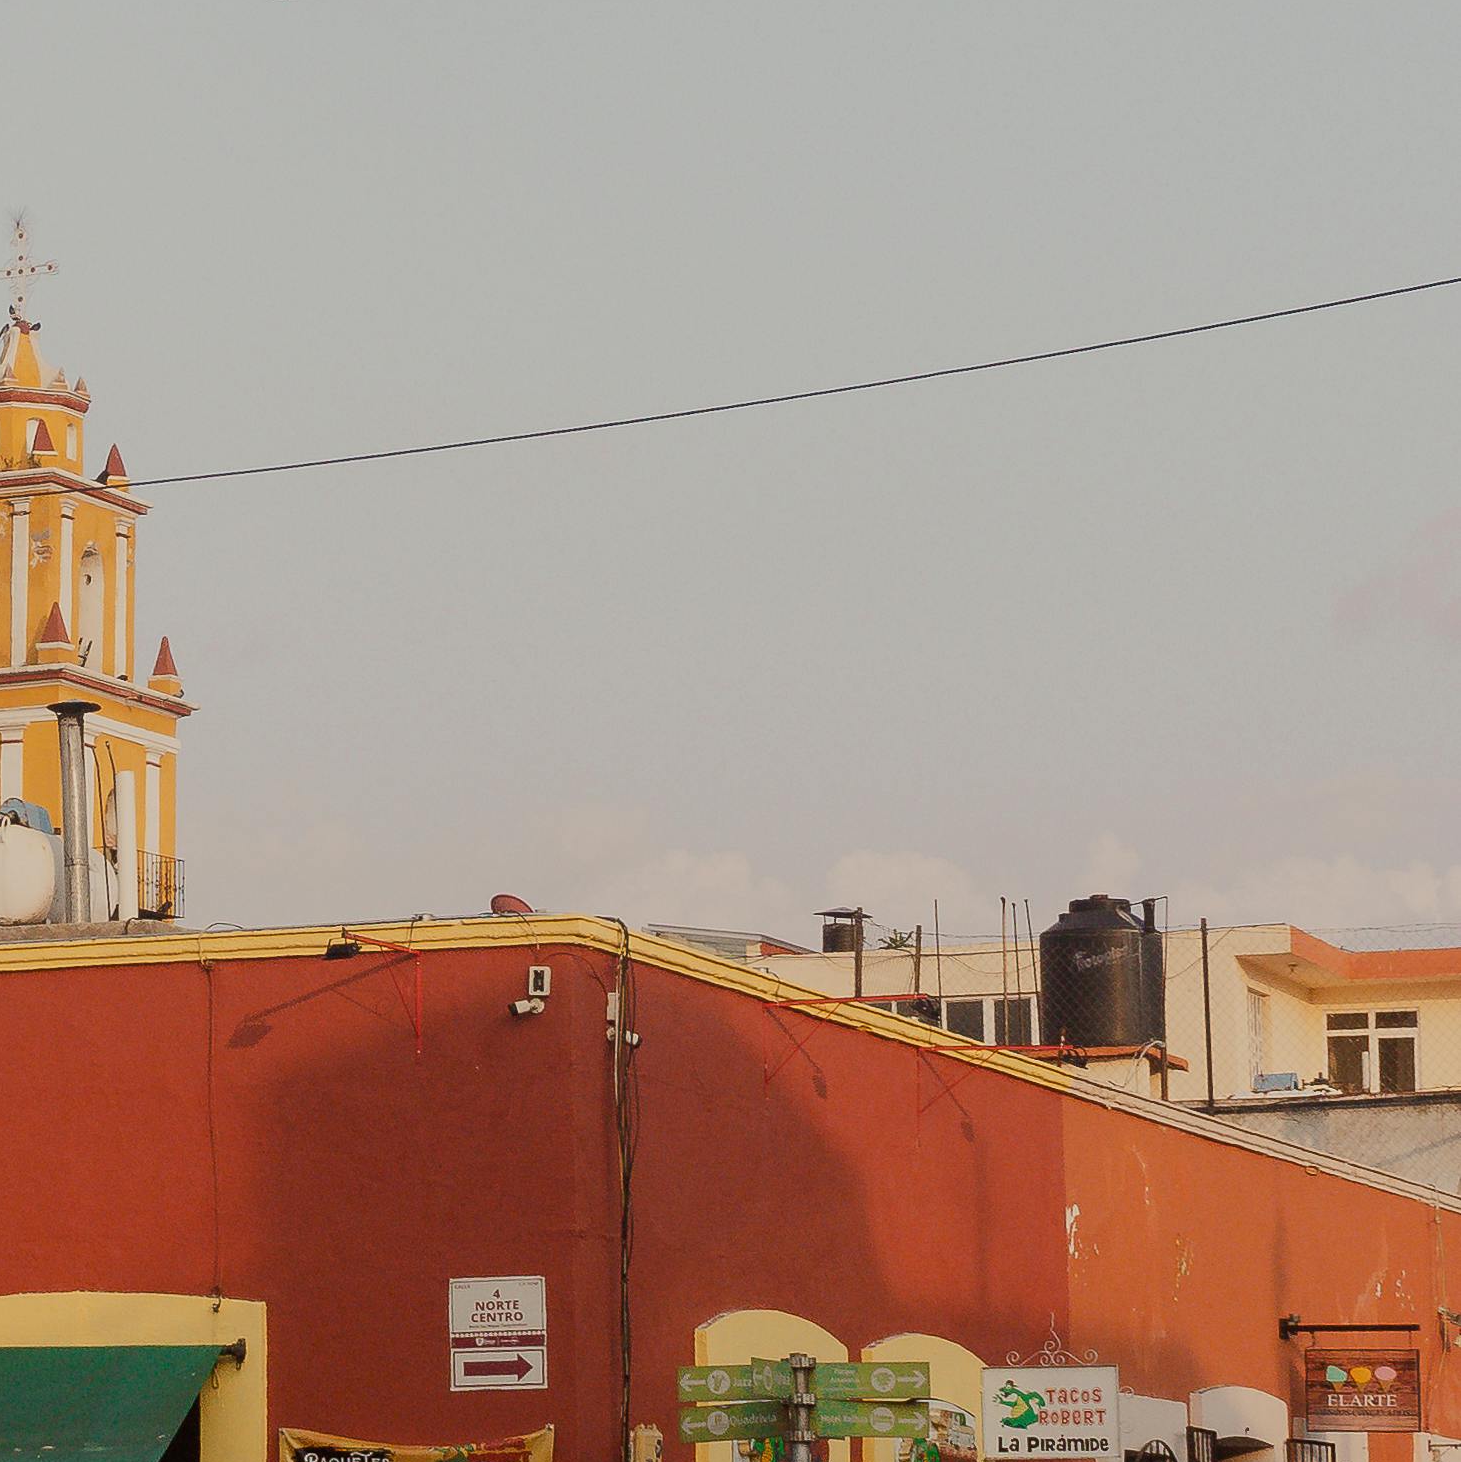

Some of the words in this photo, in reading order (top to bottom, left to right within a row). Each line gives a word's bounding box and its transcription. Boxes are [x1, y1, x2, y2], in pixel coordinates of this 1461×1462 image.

[492, 1289, 501, 1299] 4
[474, 1299, 520, 1311] NORTE
[470, 1311, 524, 1323] CENTRO
[1045, 1387, 1104, 1405] TACOS
[1326, 1393, 1398, 1407] ELARTE
[1038, 1409, 1107, 1426] ROBERT
[998, 1436, 1020, 1453] La
